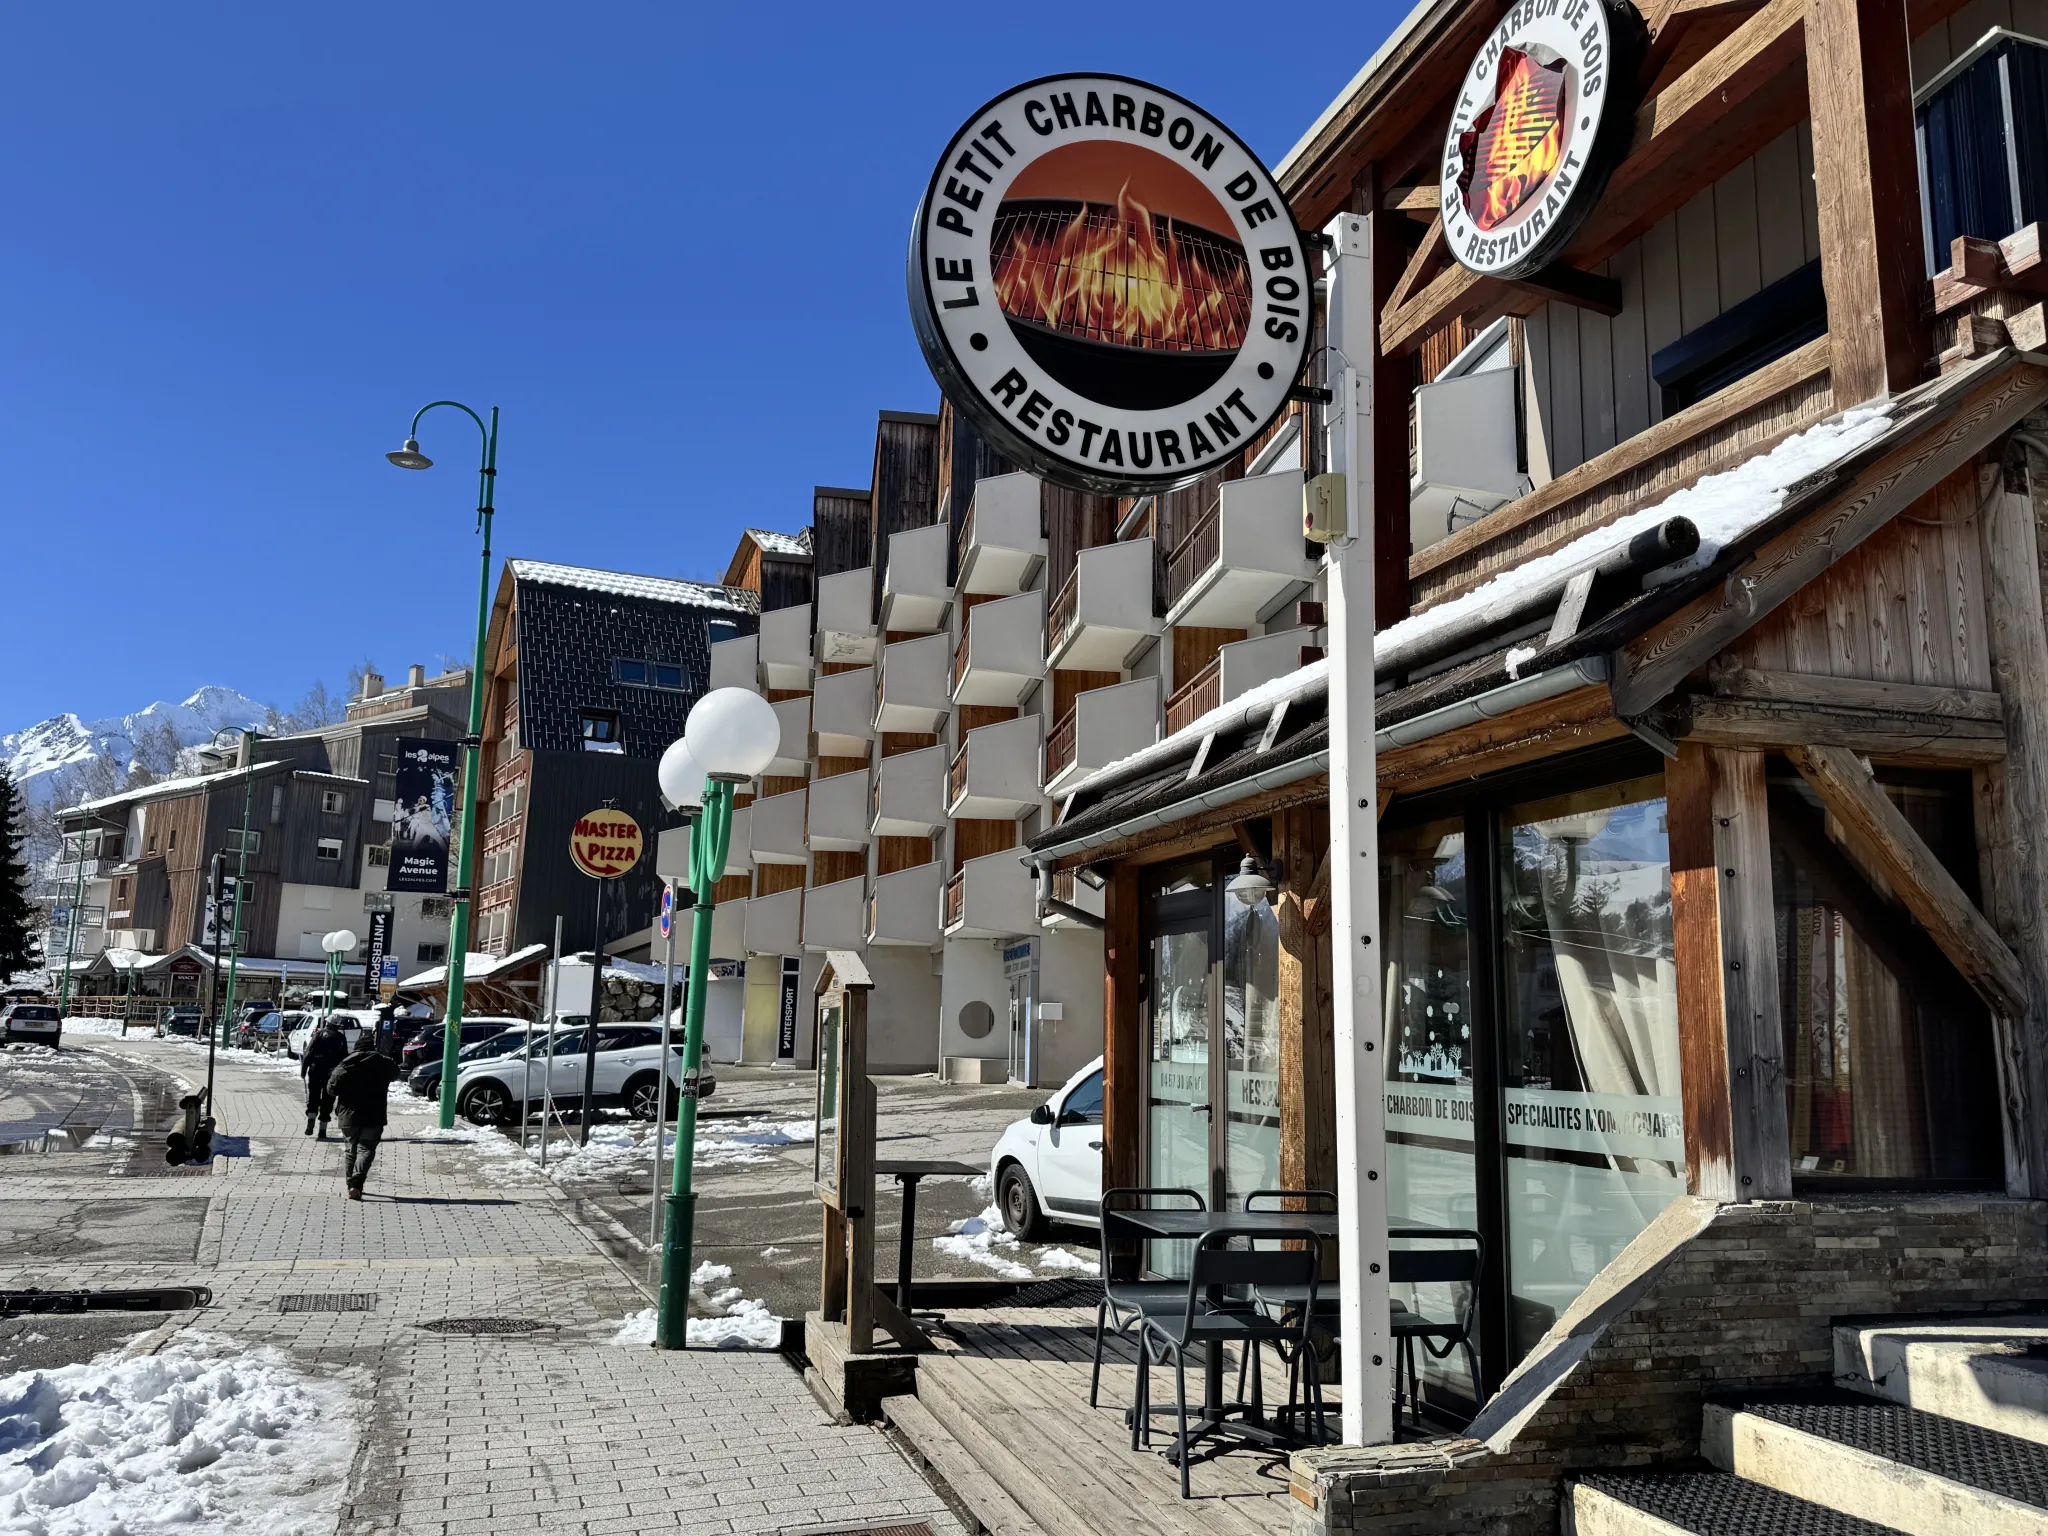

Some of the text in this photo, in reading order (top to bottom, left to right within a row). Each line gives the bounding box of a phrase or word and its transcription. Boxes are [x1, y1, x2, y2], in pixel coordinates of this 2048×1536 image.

[1445, 0, 1602, 225] LE PETIT CHARBON DE BOIS
[936, 90, 1301, 345] LE PETIT CHARBON DE BOIS
[1464, 150, 1581, 266] RESTAURANT
[989, 366, 1259, 470] RESTAURANT
[574, 819, 638, 839] MASTER
[404, 856, 435, 867] Magic
[587, 842, 636, 862] PIZZA
[399, 865, 439, 875] Avenue
[369, 924, 385, 992] INTERSPORT
[383, 1020, 390, 1030] P
[783, 987, 794, 1041] INTERSPORT
[1387, 1094, 1474, 1122] CHARBON DE BOIS
[1507, 1102, 1581, 1131] SPECIALITES
